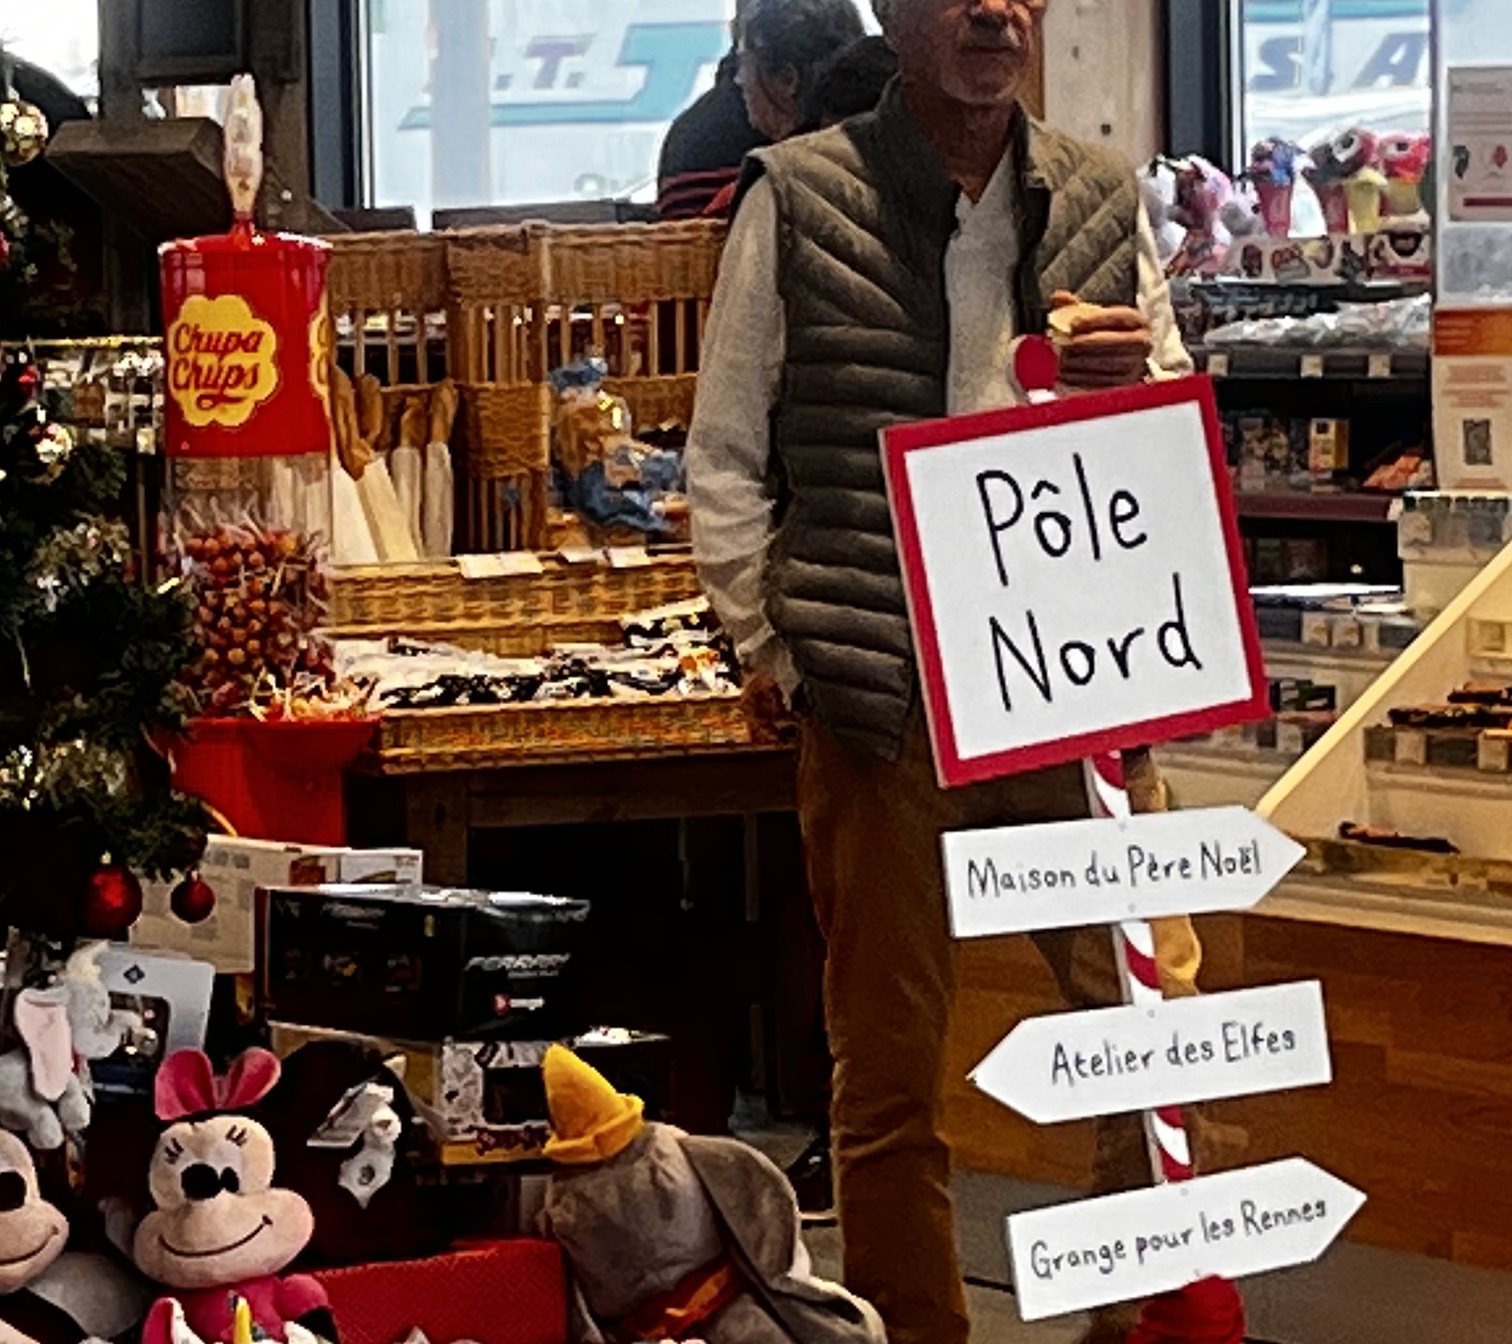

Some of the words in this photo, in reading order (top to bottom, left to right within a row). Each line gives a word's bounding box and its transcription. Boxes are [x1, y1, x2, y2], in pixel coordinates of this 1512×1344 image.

[174, 323, 265, 360] Chupa
[172, 356, 261, 405] Chups
[975, 452, 1147, 587] Pôle
[989, 571, 1203, 712] Nord
[966, 856, 1077, 899] Maison
[1084, 850, 1121, 888] du
[1126, 843, 1192, 887] Père
[1199, 839, 1263, 881] Noël
[1051, 1038, 1156, 1087] Atelier
[1164, 1029, 1215, 1068] des
[1220, 1019, 1297, 1063] Elfes
[1029, 1239, 1128, 1280] Grange
[1135, 1227, 1194, 1265] pour
[1199, 1211, 1236, 1244] les
[1240, 1198, 1328, 1238] Rennes
